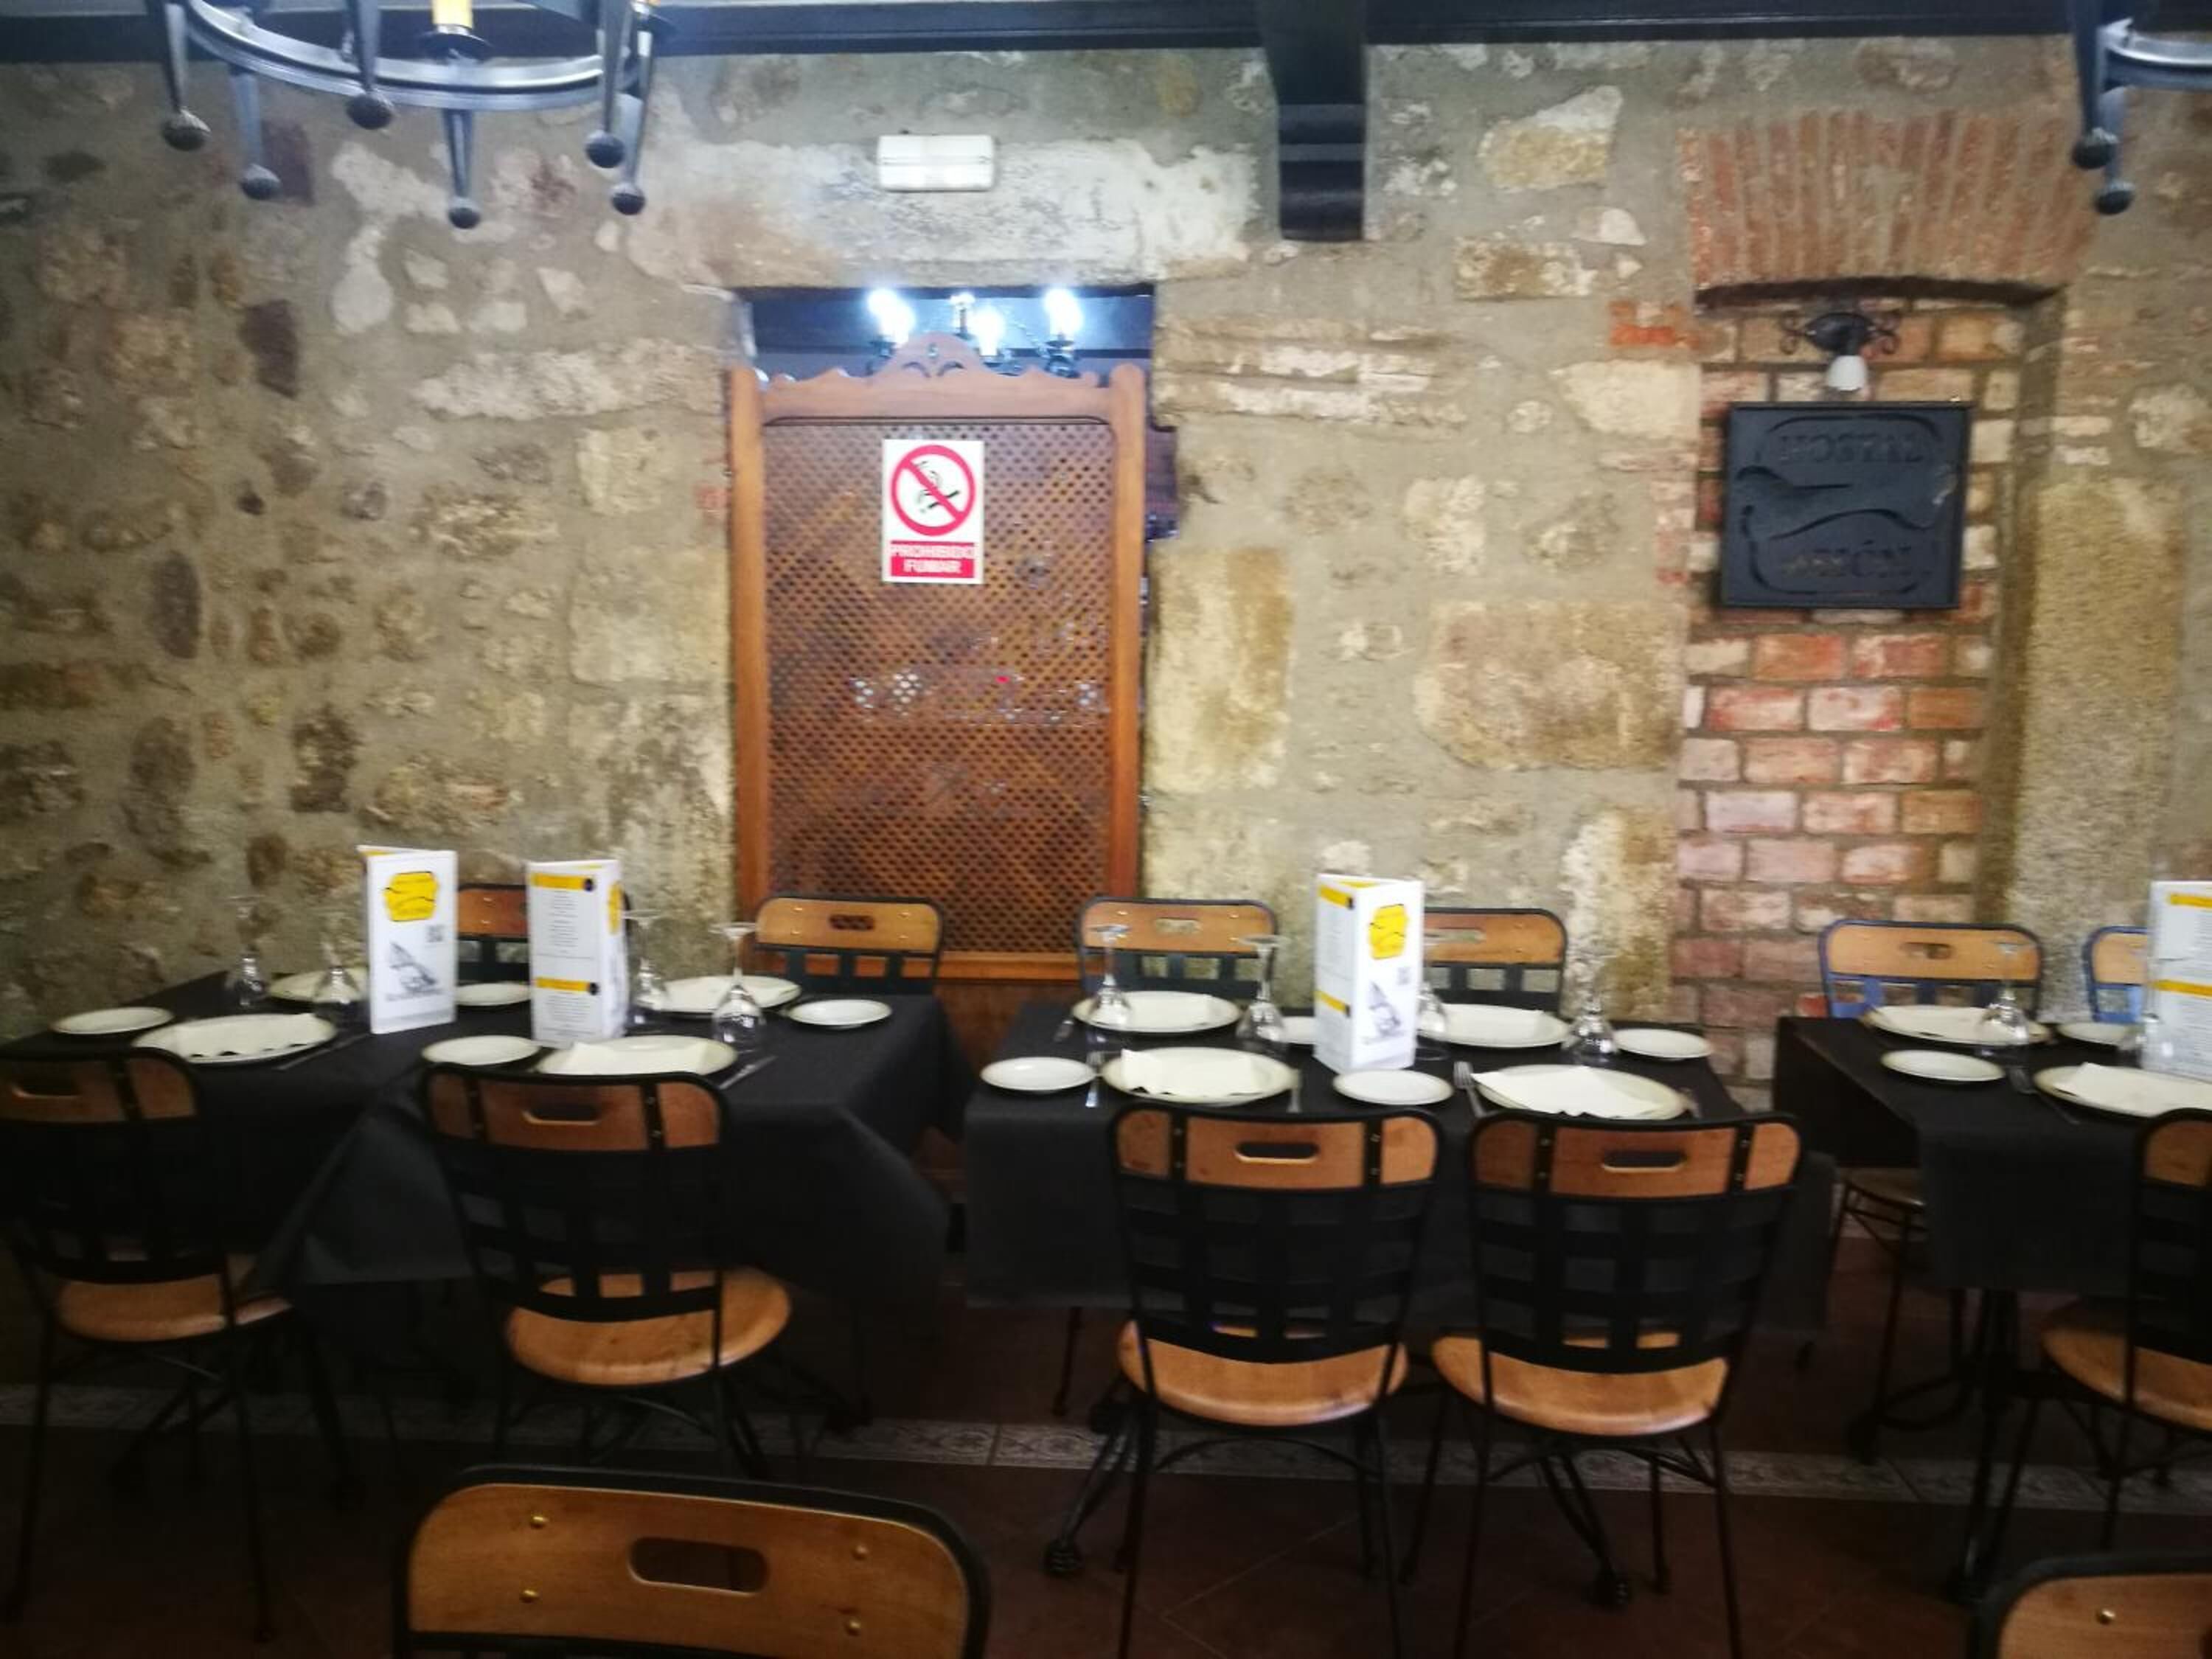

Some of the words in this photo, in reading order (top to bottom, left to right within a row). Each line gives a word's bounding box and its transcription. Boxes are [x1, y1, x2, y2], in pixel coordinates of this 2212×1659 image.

[1779, 433, 1924, 463] HOSTAL
[890, 543, 975, 559] PROHIBIDO
[902, 559, 964, 574] FUMAR
